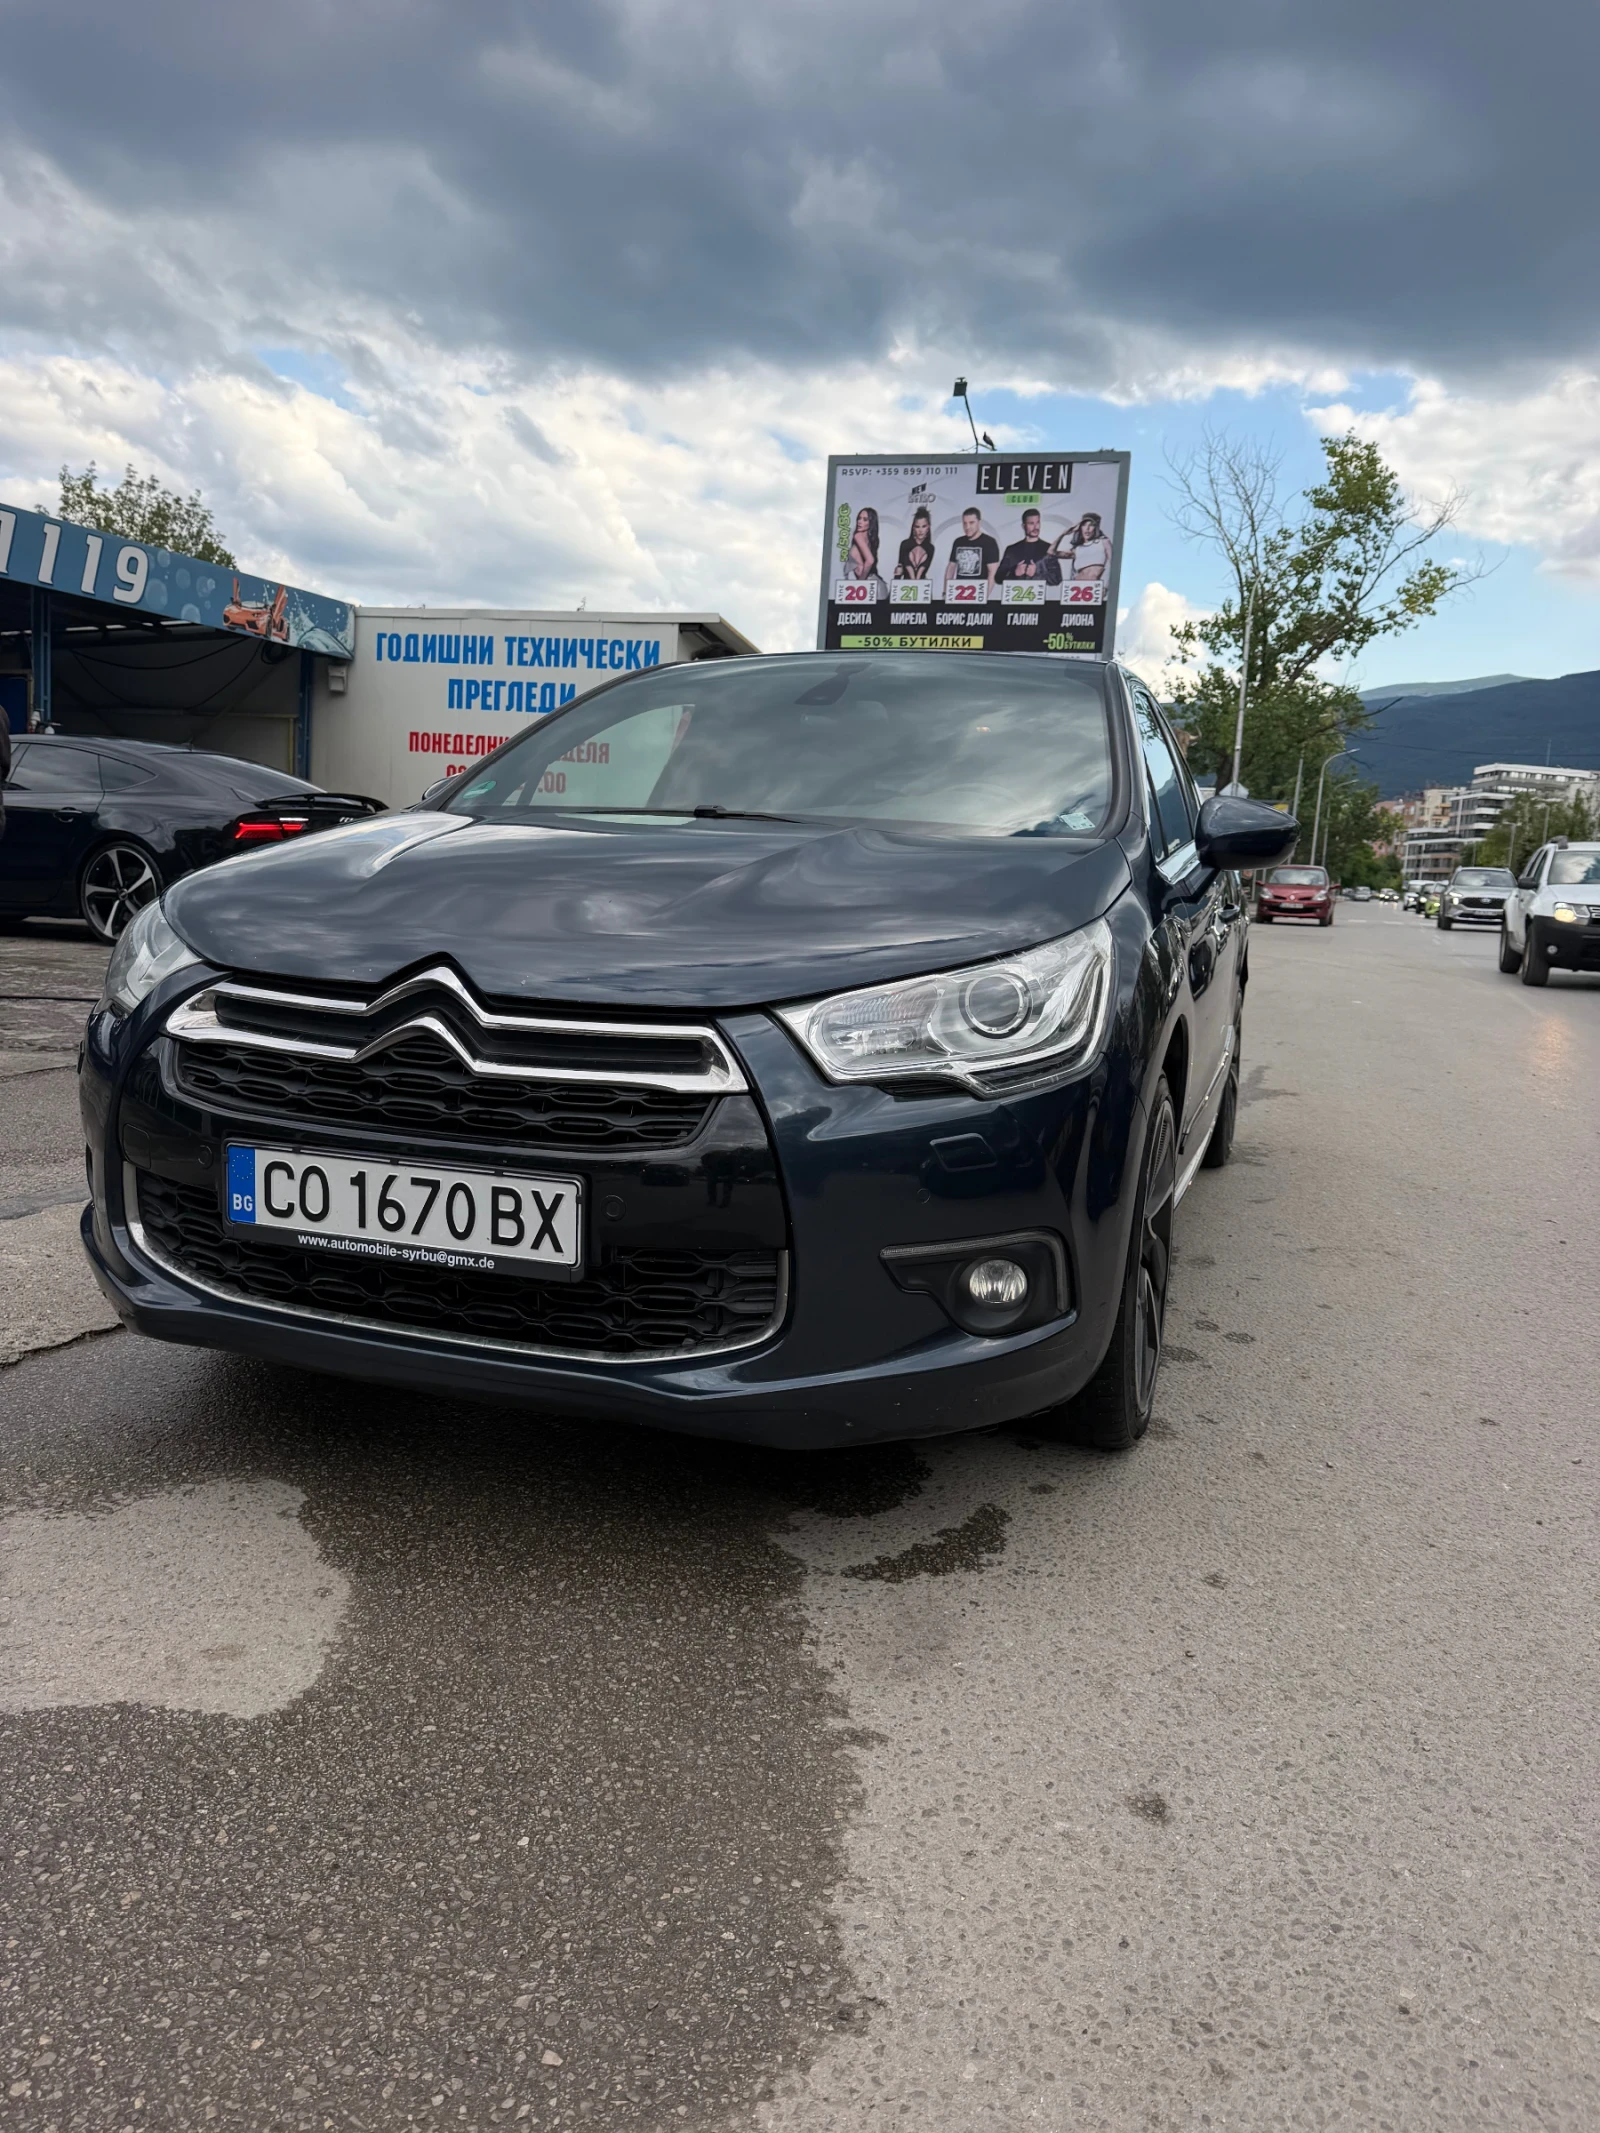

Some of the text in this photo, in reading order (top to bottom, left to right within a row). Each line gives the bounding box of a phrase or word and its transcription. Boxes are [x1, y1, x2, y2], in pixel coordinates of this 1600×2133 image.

[841, 466, 958, 476] RSVP: +359 899 110 111
[980, 464, 1069, 490] ELEVEN
[845, 585, 868, 601] 20
[900, 585, 918, 601] 21
[923, 584, 931, 601] TUE
[955, 585, 977, 601] 22
[1011, 586, 1036, 602] 24
[1069, 586, 1093, 602] 26
[1093, 583, 1101, 603] SUN
[837, 612, 872, 626] ДЕСИТА
[890, 612, 928, 625] МИРЕЛА
[936, 612, 994, 627] БОРИС ДАЛИ
[1006, 613, 1039, 626] ГАЛИН
[1060, 613, 1095, 627] ДИОНА
[858, 637, 972, 648] -50% БУТИЛКИ
[1043, 633, 1074, 650] -50%
[376, 632, 661, 670] ГОДИШНИ ТЕХНИЧЕСКИ
[448, 678, 577, 714] ПРЕГЛЕДИ
[232, 1193, 254, 1212] BG
[263, 1160, 565, 1254] CO 1670 BX
[298, 1233, 495, 1270] www.automobile-syrbu@gmx.de
